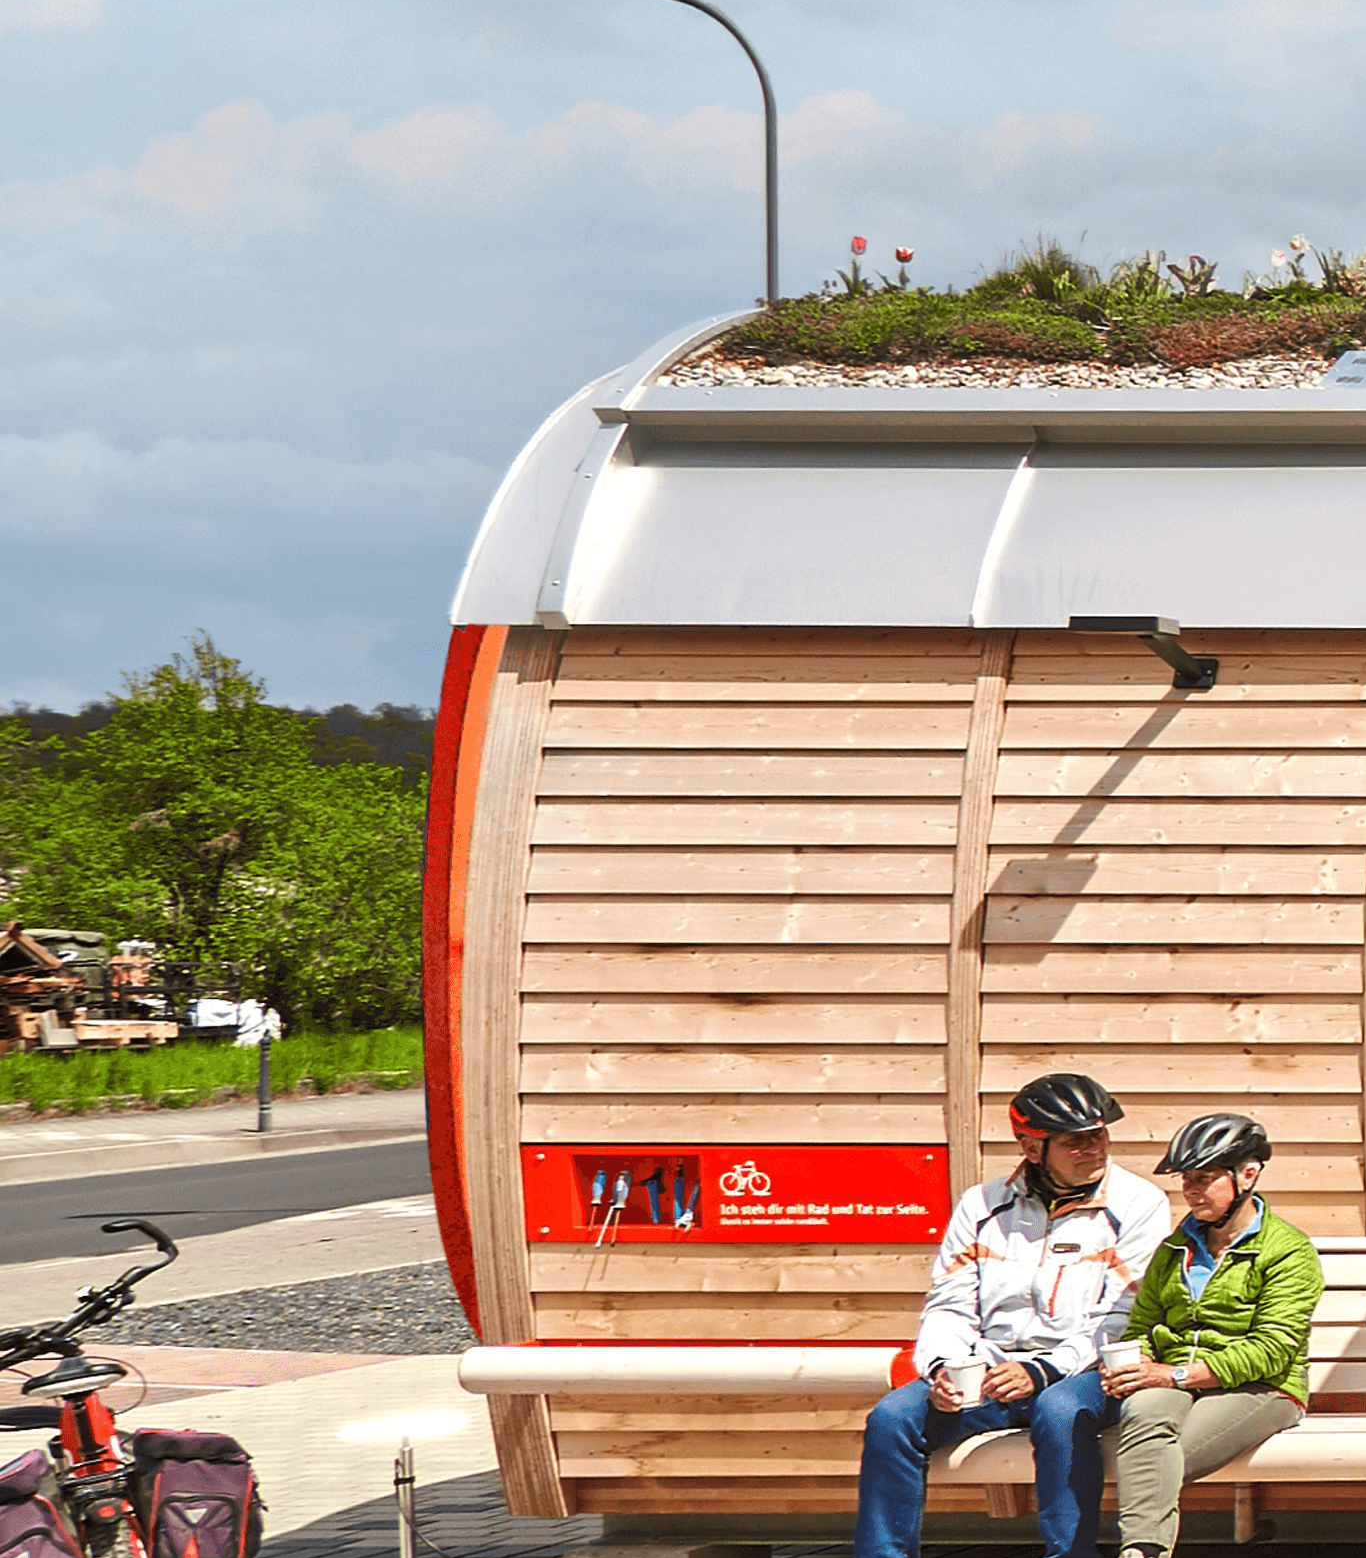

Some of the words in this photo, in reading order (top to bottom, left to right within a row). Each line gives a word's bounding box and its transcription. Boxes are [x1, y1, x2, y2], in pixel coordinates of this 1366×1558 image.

[720, 1203, 739, 1215] Ich
[740, 1203, 766, 1215] steh
[767, 1203, 784, 1215] dir
[786, 1203, 806, 1215] mit
[807, 1203, 830, 1215] Rad
[831, 1203, 854, 1215] und
[855, 1203, 875, 1215] Tat
[876, 1204, 894, 1215] zur
[895, 1203, 930, 1215] Seite.
